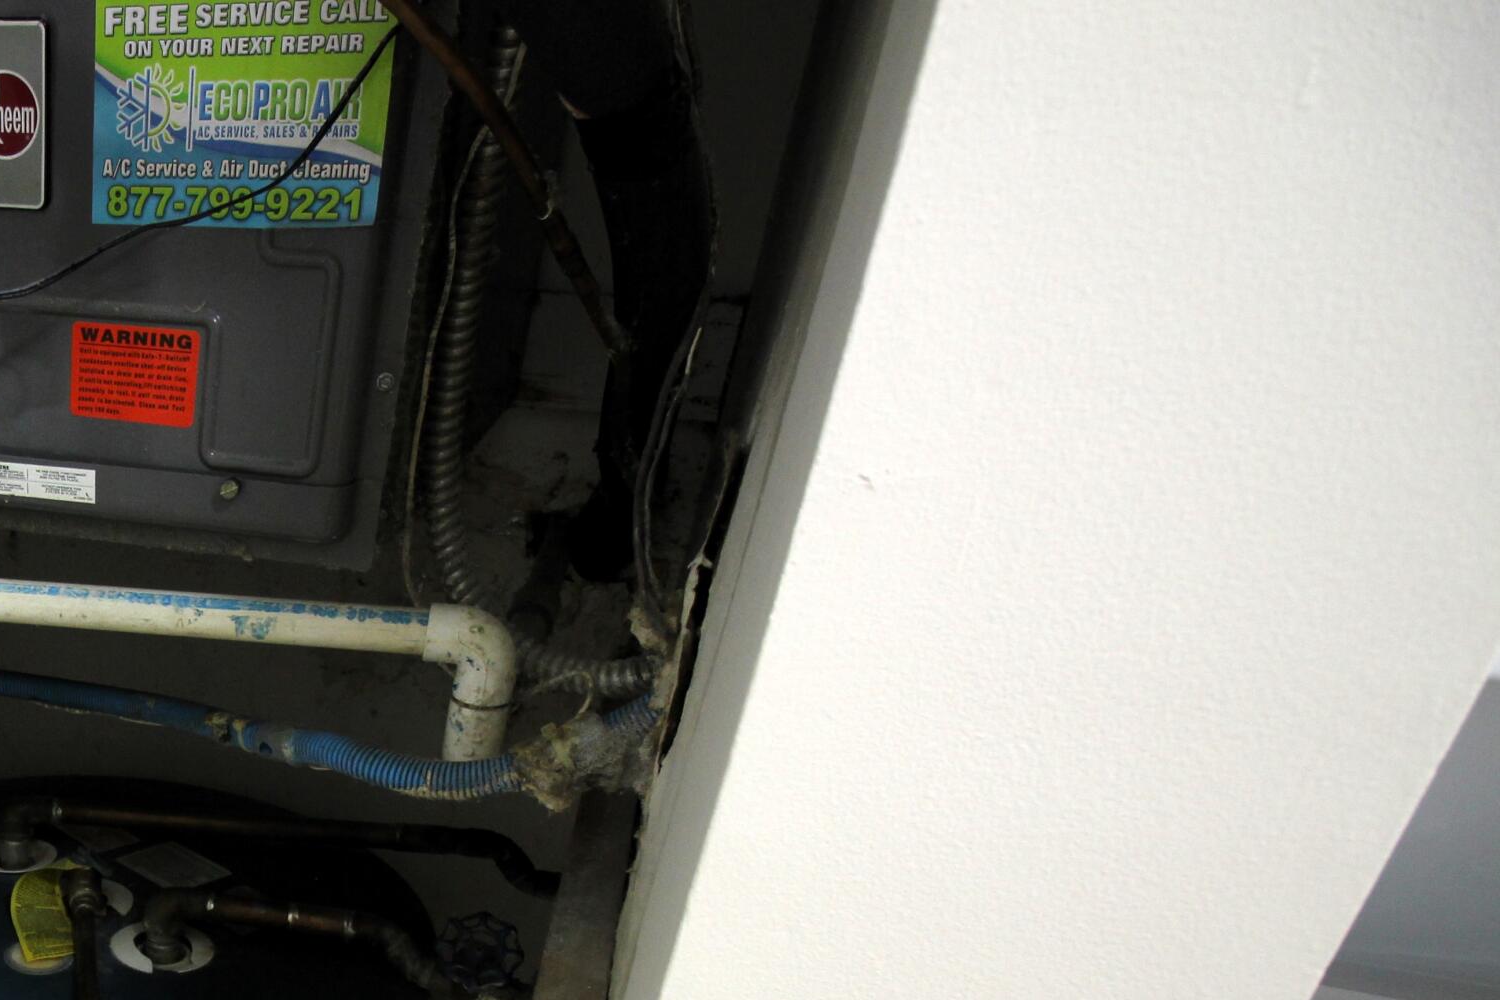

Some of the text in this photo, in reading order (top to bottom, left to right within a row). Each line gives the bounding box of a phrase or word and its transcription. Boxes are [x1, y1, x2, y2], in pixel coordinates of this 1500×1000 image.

[104, 0, 389, 37] FREE SERVICE CALL
[124, 33, 364, 58] ON YOUR NEXT REPAIR
[197, 124, 358, 139] AC SERVICE, SALES & RPAIRS
[102, 158, 131, 178] A/C
[136, 159, 197, 178] Service
[202, 160, 213, 178] &
[220, 160, 244, 178] Air
[248, 160, 287, 178] Duct
[107, 185, 362, 221] 877-799-9221
[80, 327, 193, 350] WARNING
